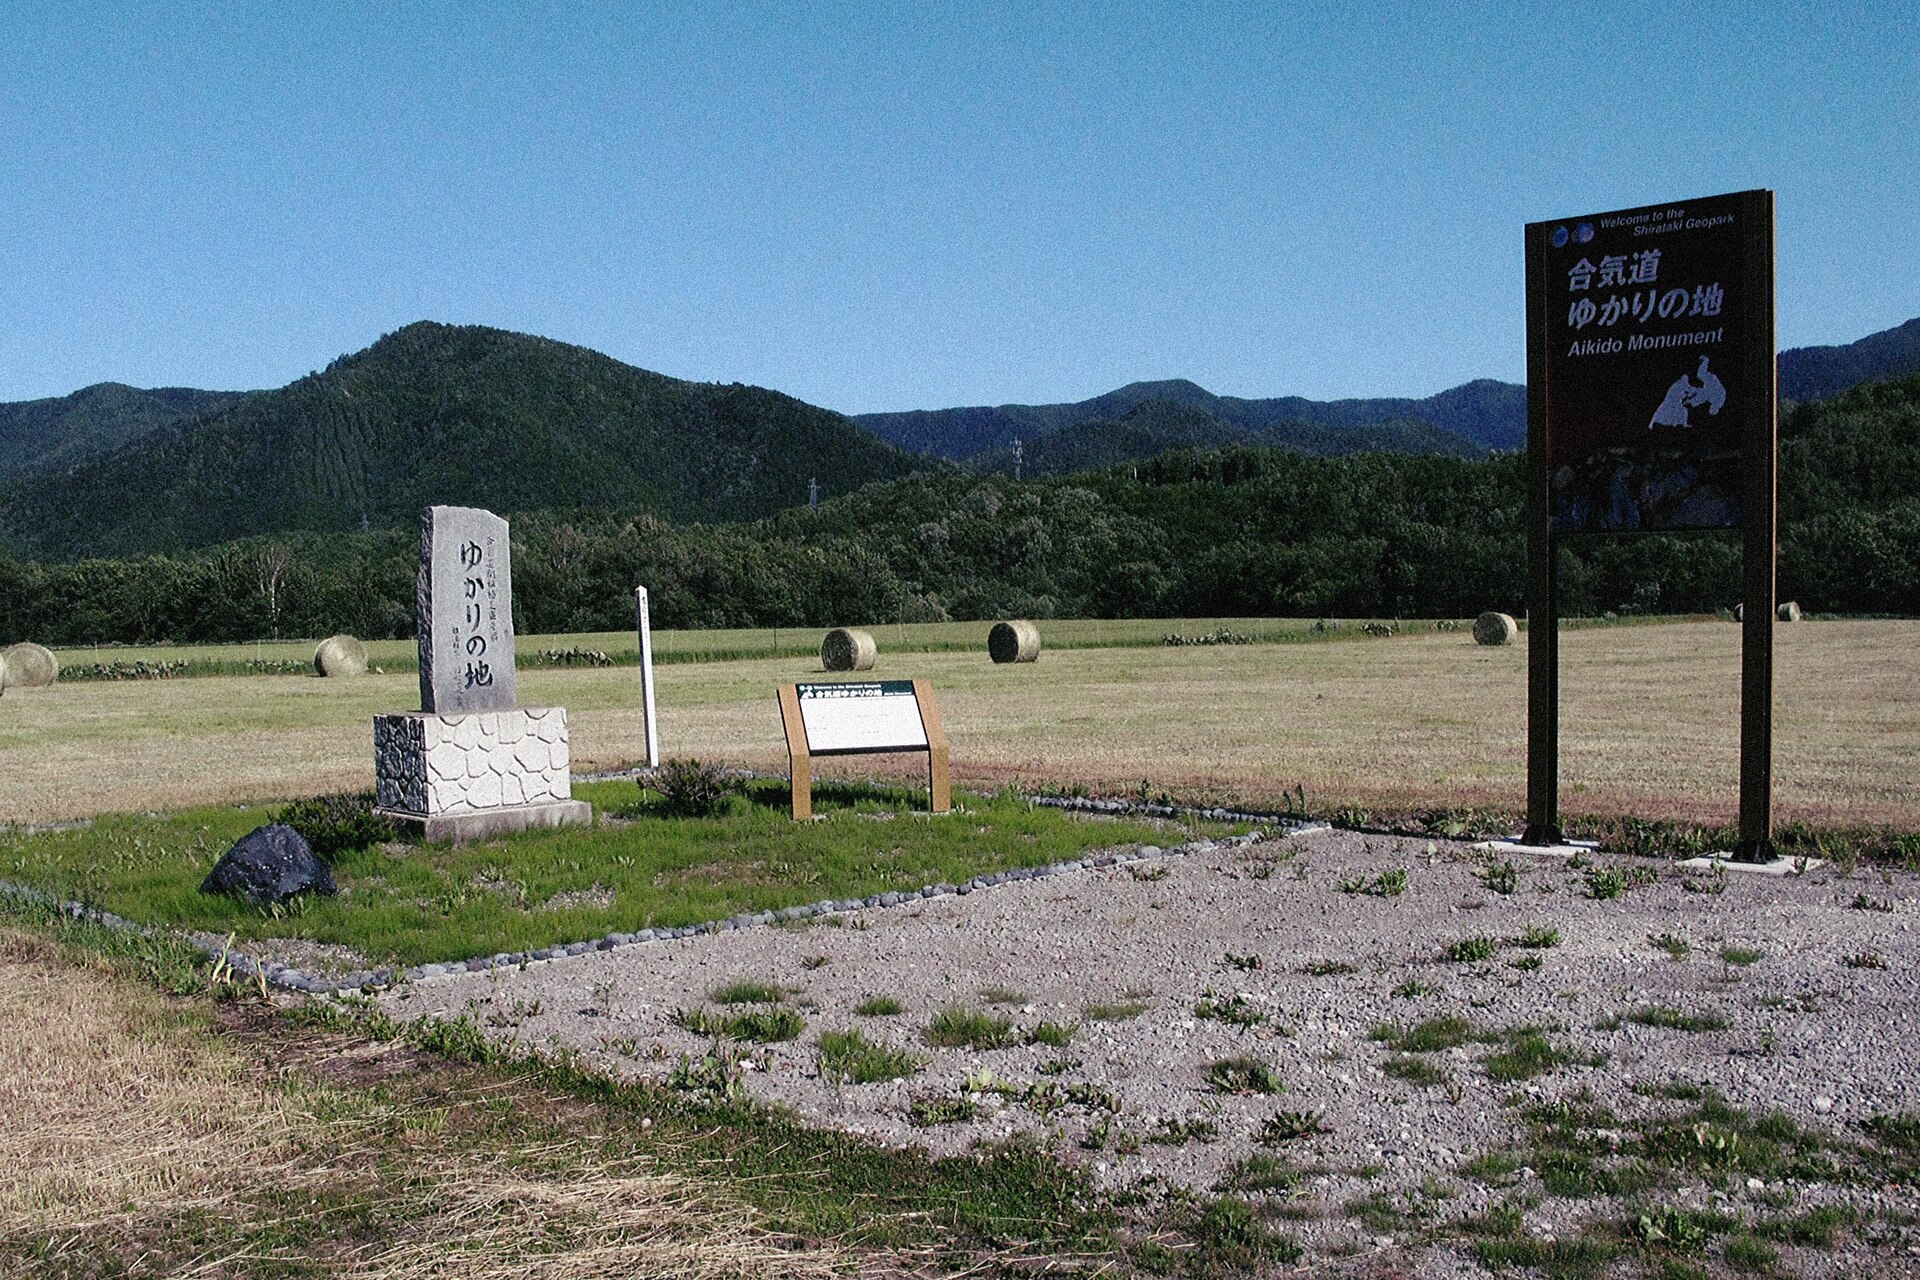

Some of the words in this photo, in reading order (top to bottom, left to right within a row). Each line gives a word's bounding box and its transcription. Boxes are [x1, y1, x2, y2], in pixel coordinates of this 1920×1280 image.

[1600, 214, 1650, 229] Welcome
[1653, 211, 1664, 222] to
[1666, 208, 1685, 219] the
[1633, 220, 1683, 237] Shirataki
[1685, 213, 1735, 230] Geopark
[1567, 248, 1661, 292] 合気道
[1567, 282, 1724, 330] ゆかりの地
[1567, 337, 1622, 357] Aikido
[1628, 326, 1724, 351] Monument
[460, 540, 493, 690] ゆかりの地
